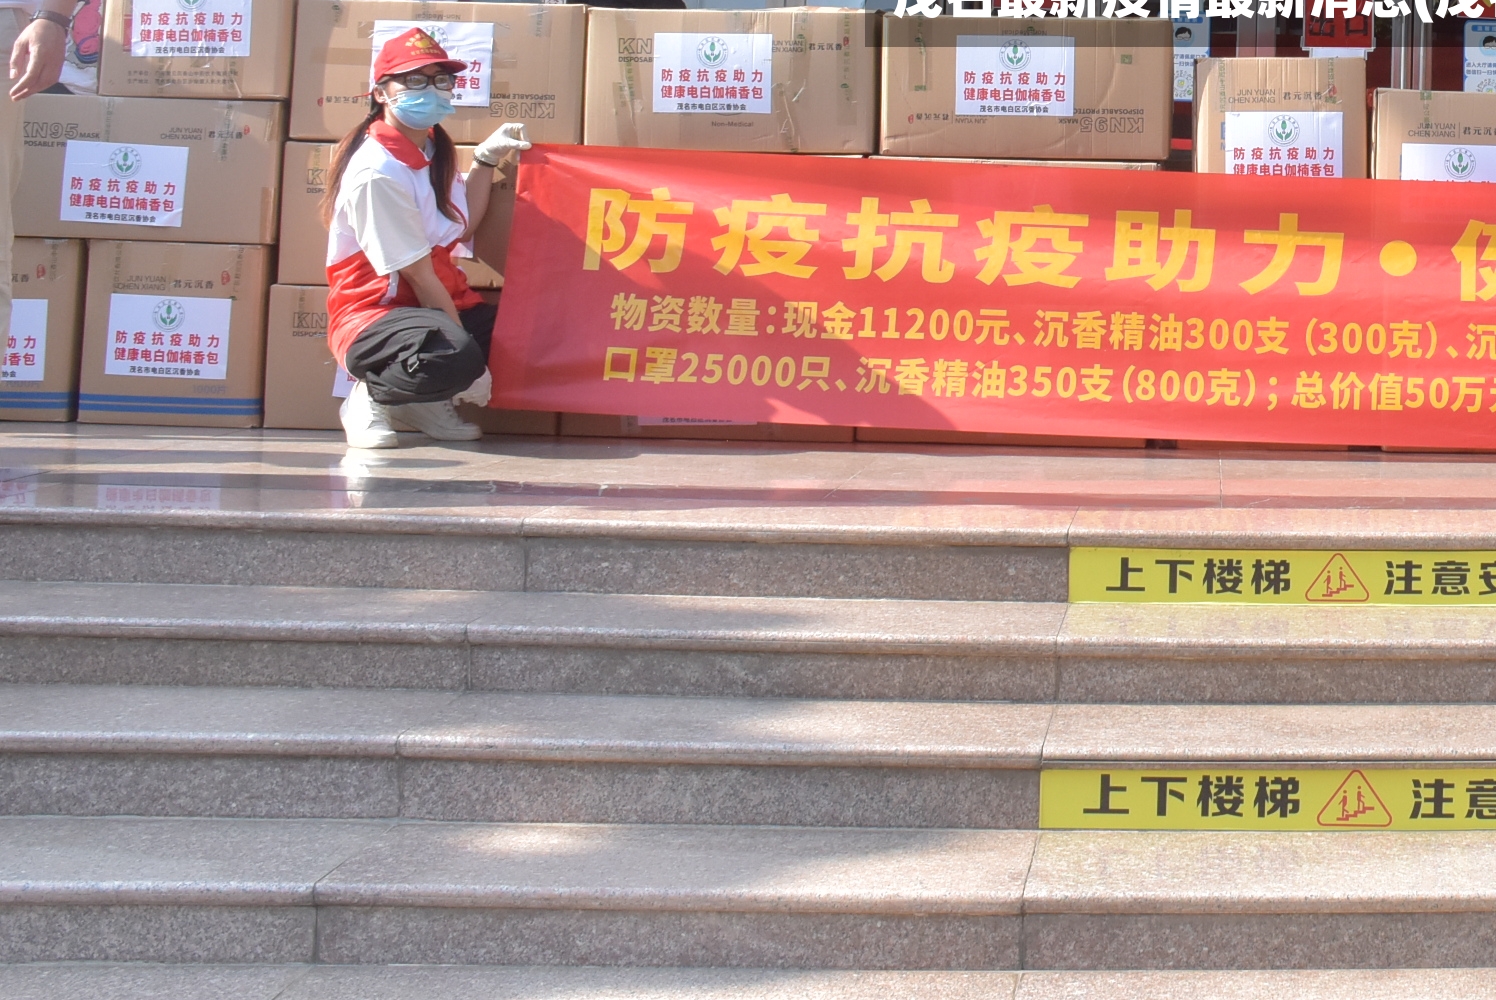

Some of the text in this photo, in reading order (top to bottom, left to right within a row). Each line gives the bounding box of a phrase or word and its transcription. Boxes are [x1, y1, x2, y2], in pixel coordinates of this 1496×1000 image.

[140, 12, 243, 26] 防疫抗疫助力
[140, 29, 242, 42] 健康电白伽楠香包
[661, 69, 763, 83] 防疫抗疫助力
[964, 71, 1066, 85] 防疫抗疫助力
[660, 85, 763, 99] 健康电白伽楠香包
[963, 87, 1066, 102] 健康电白伽楠香包
[1080, 116, 1145, 133] KN95
[1233, 147, 1334, 160] 防疫抗疫助力
[1233, 163, 1334, 176] 健康电白伽楠香包
[70, 177, 176, 196] 防疫抗疫助力
[69, 193, 174, 212] 健康电白伽楠香包
[115, 330, 220, 348] 防疫抗疫助力
[114, 347, 219, 365] 健康电白伽楠香包
[1105, 556, 1292, 595] 上下楼梯
[1083, 772, 1302, 818] 上下楼梯
